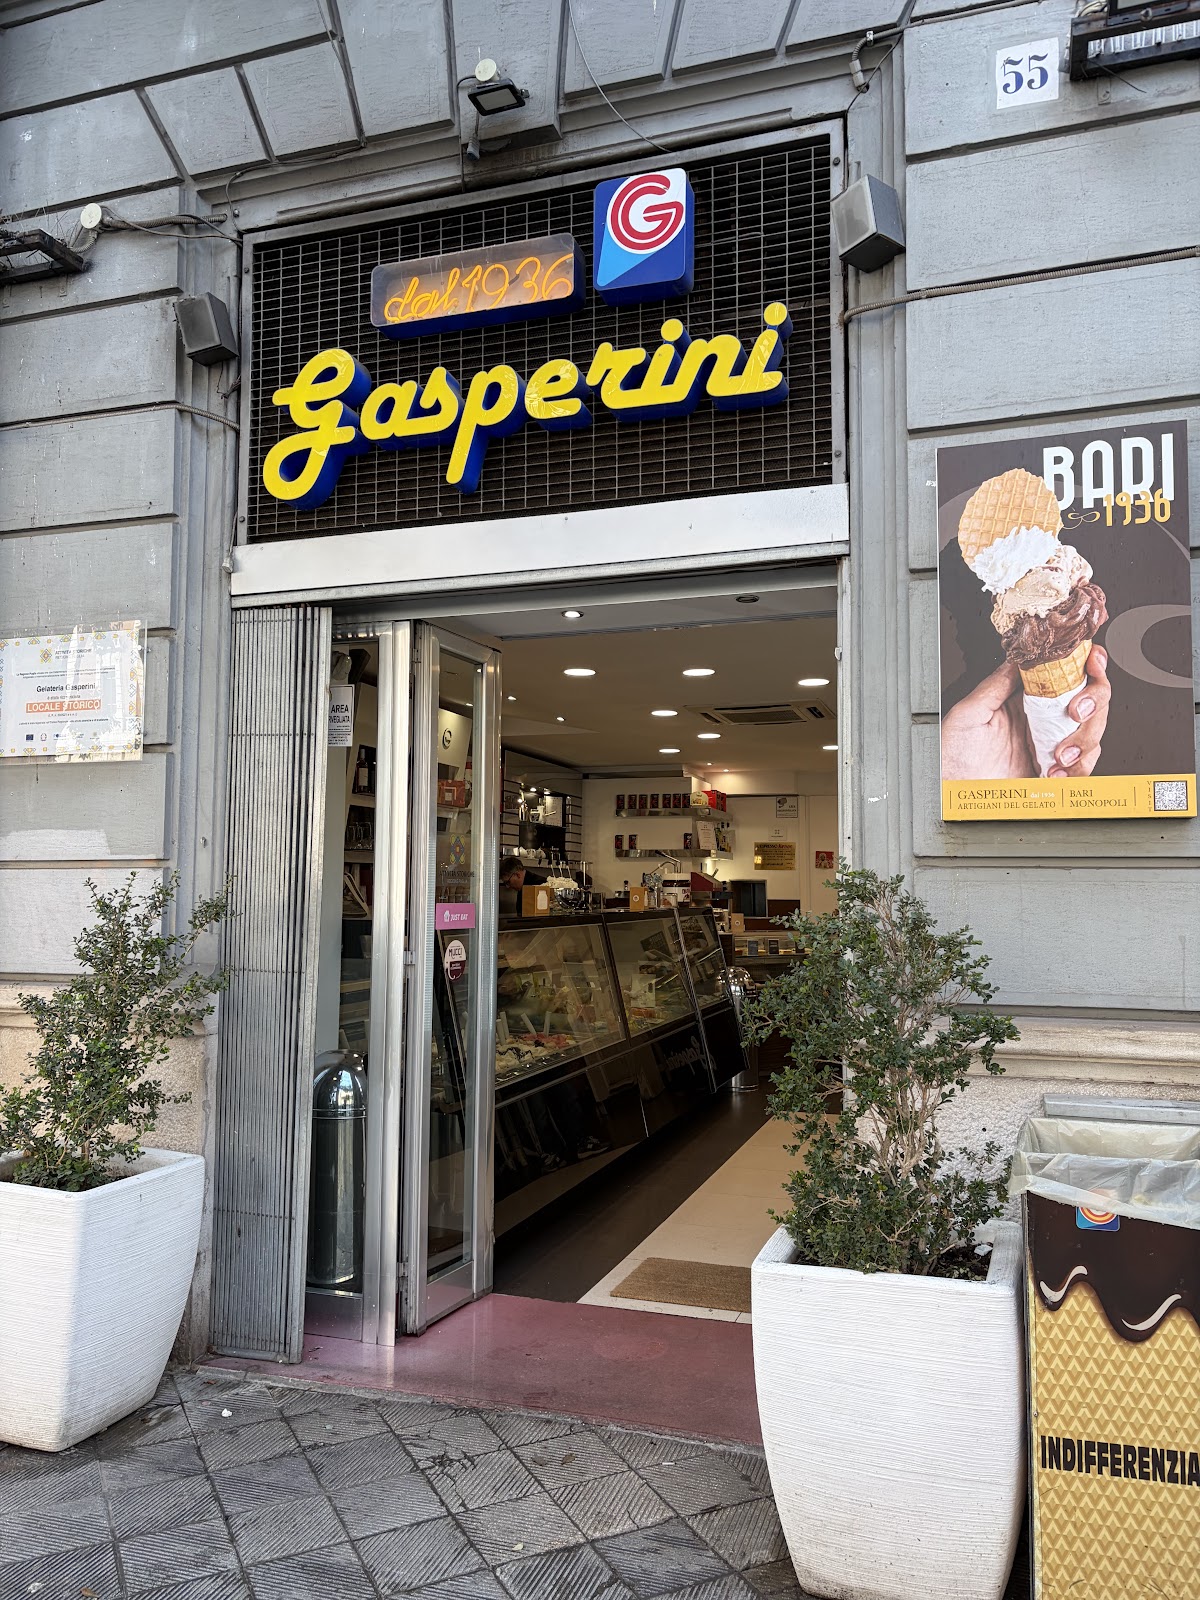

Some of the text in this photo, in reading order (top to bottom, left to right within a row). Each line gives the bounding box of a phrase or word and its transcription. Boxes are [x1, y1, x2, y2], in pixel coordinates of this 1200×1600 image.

[1002, 53, 1049, 94] 55
[609, 172, 685, 251] G
[384, 253, 574, 323] dal 1936
[263, 301, 786, 500] Gasperini
[1043, 433, 1174, 511] BARI
[1104, 488, 1171, 527] 1936
[37, 685, 64, 693] Gelateria
[27, 700, 100, 712] LOCALE STORICO
[331, 704, 349, 713] AREA
[957, 789, 1028, 800] GASPERINI
[1069, 789, 1094, 798] BARI
[957, 802, 1001, 810] ARTIGIANI
[1022, 801, 1056, 809] GELATO
[1069, 799, 1128, 808] MONOPOLI
[460, 913, 468, 921] EAT
[1041, 1435, 1200, 1487] INDIFFERENZIA
